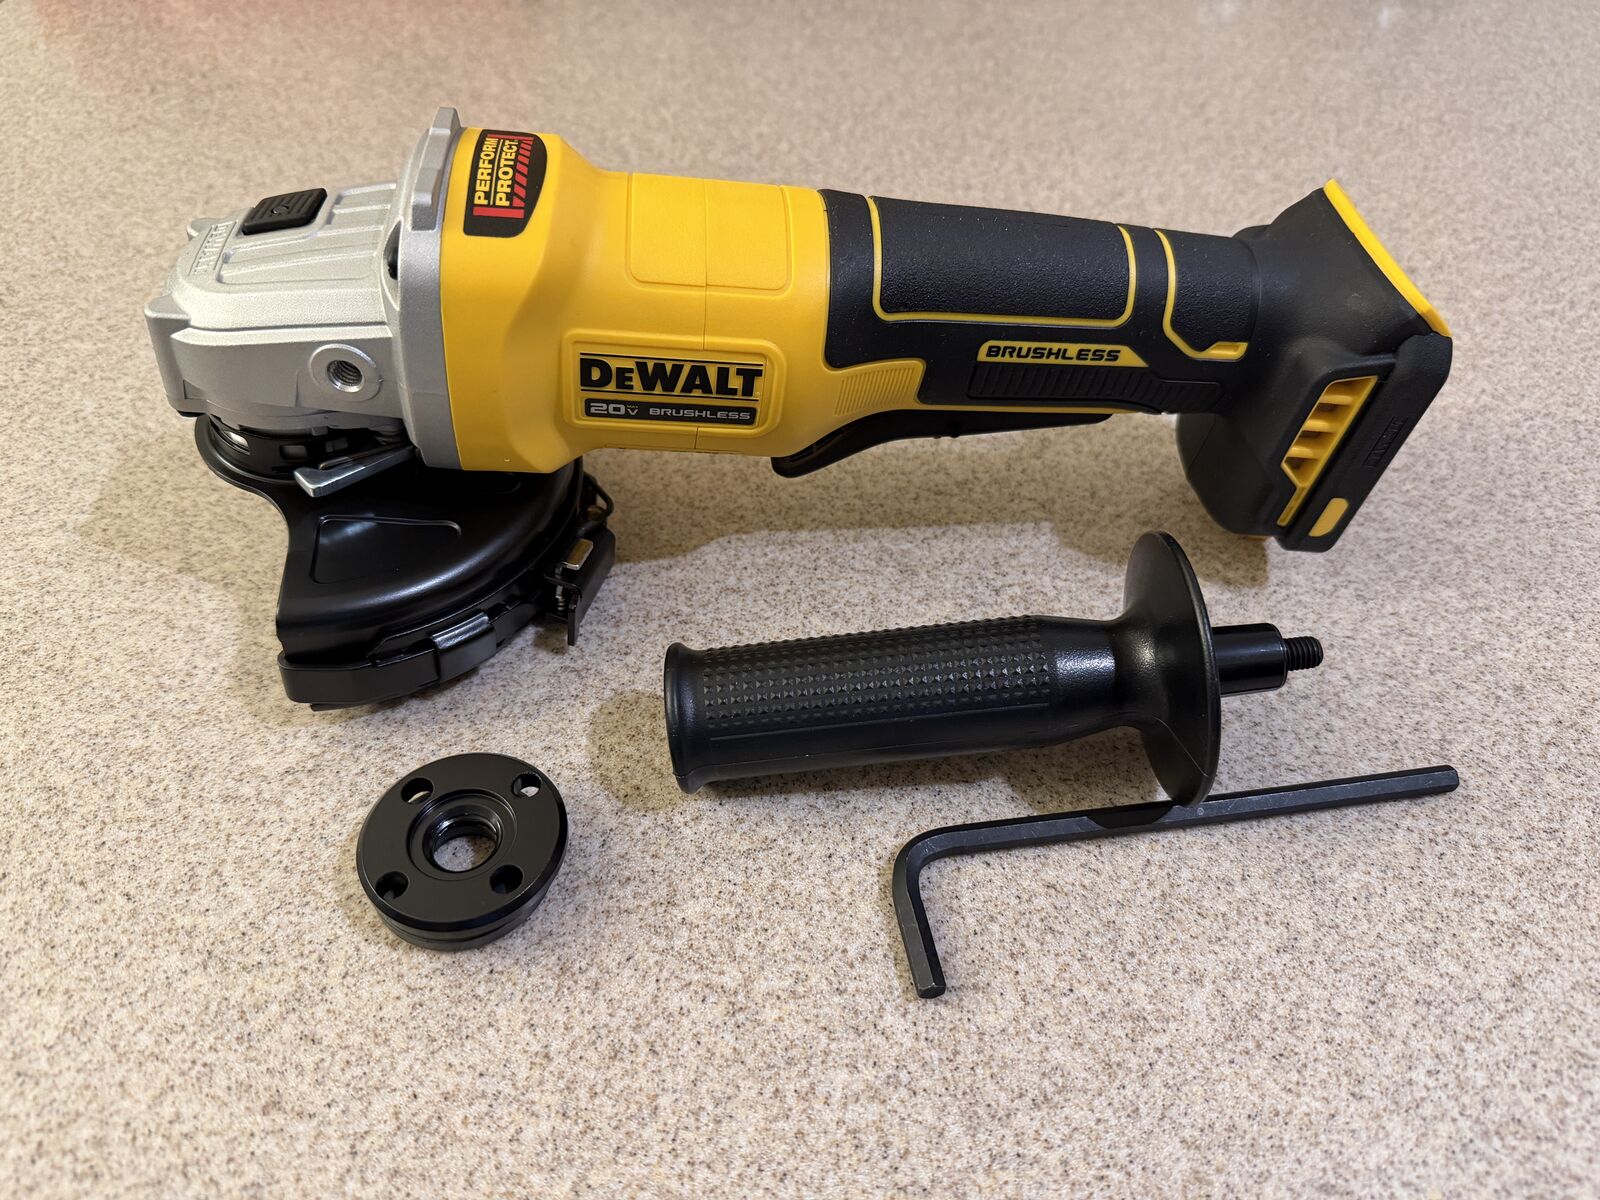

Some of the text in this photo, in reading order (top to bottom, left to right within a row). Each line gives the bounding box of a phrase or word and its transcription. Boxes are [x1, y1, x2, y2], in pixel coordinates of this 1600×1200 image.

[474, 138, 499, 205] PERFORM
[495, 139, 519, 206] PROTECT
[985, 345, 1121, 362] BRUSHLESS
[649, 407, 751, 420] BRUSHLESS
